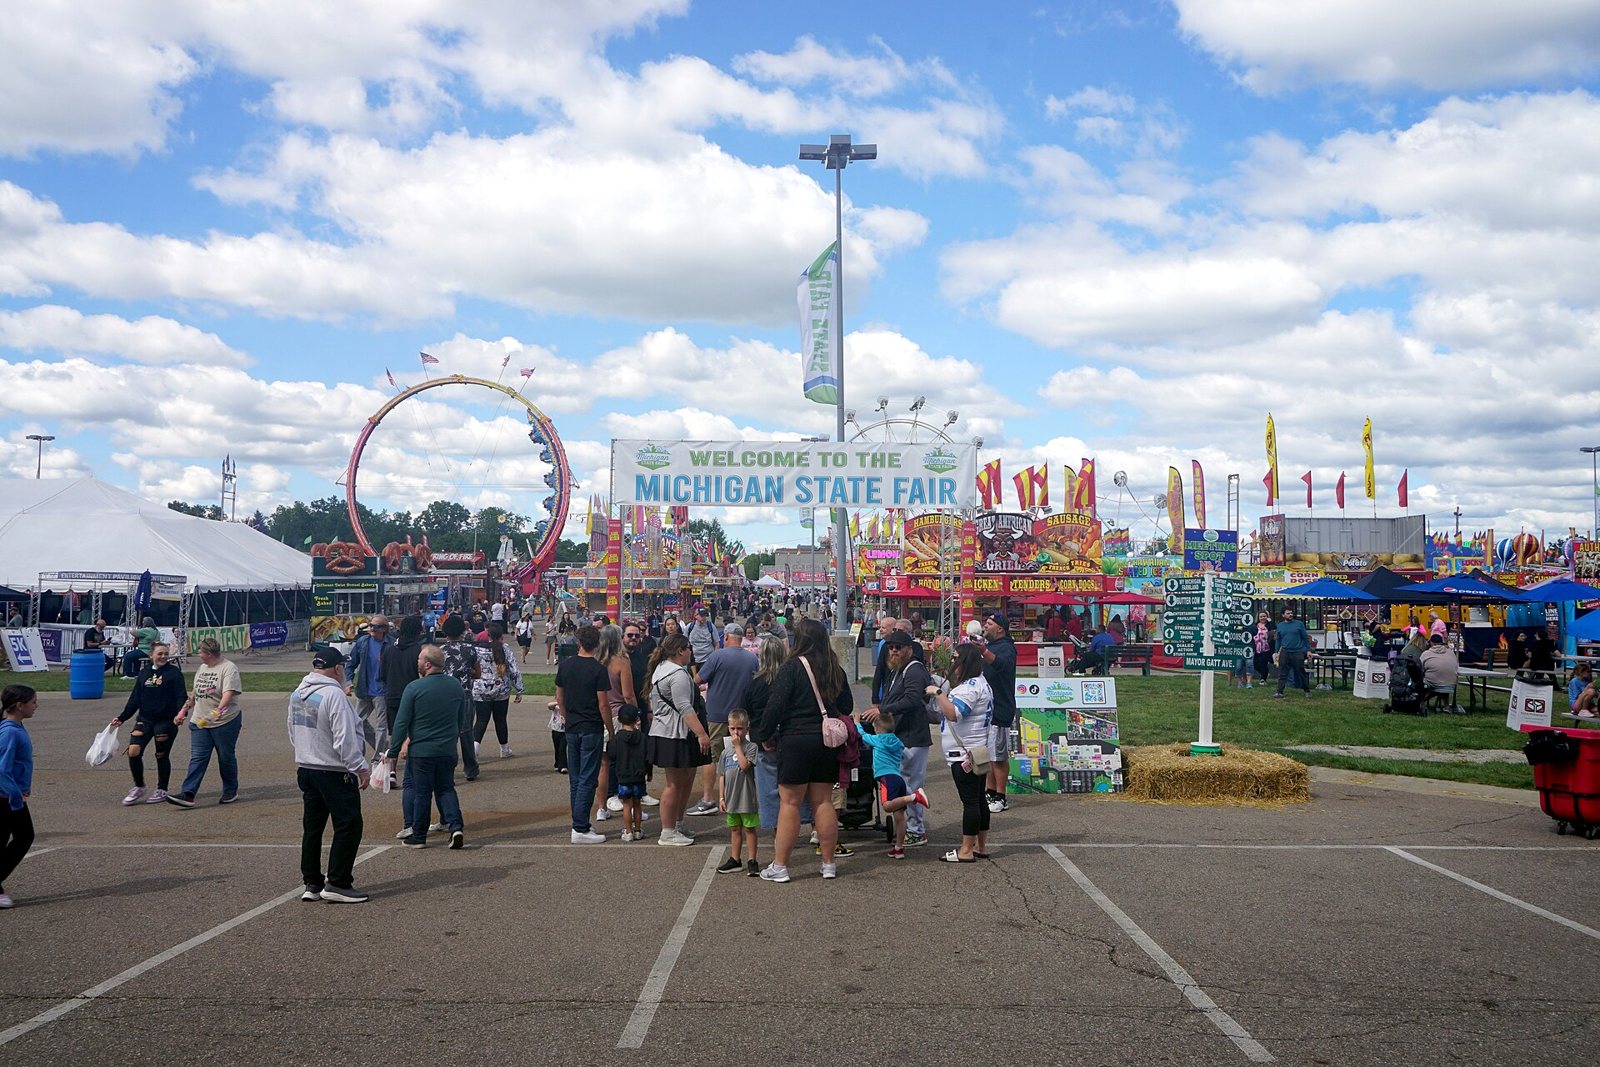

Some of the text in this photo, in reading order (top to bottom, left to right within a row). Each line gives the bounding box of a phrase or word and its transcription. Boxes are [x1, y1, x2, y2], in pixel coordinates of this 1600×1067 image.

[635, 453, 670, 462] Michigan
[689, 450, 902, 469] WELCOME TO THE
[922, 456, 956, 465] Michigan
[635, 473, 958, 505] MICHIGAN STATE FAIR
[999, 514, 1032, 536] AMERICAN
[1047, 514, 1091, 527] SAUSAGE
[1184, 540, 1237, 552] MEETING
[1579, 543, 1600, 552] AUTH
[431, 552, 473, 560] RING OF FIRE
[1194, 550, 1225, 561] SPOT
[986, 559, 1021, 571] GRILL
[1133, 557, 1170, 566] HAWAIIAN
[1215, 560, 1222, 571] 2
[1343, 559, 1367, 567] Potato
[60, 572, 112, 580] ENTERTAINMENT
[1118, 567, 1163, 577] SHAVED ICE
[974, 579, 999, 590] ICKEN
[1014, 579, 1050, 590] TENDERS
[1058, 579, 1096, 590] CORN DOGS
[1177, 597, 1191, 605] BUTTER
[10, 637, 28, 652] 5K
[42, 638, 55, 647] TRA
[220, 626, 246, 652] TENT
[1185, 657, 1235, 668] MAYOR GATT AVE.
